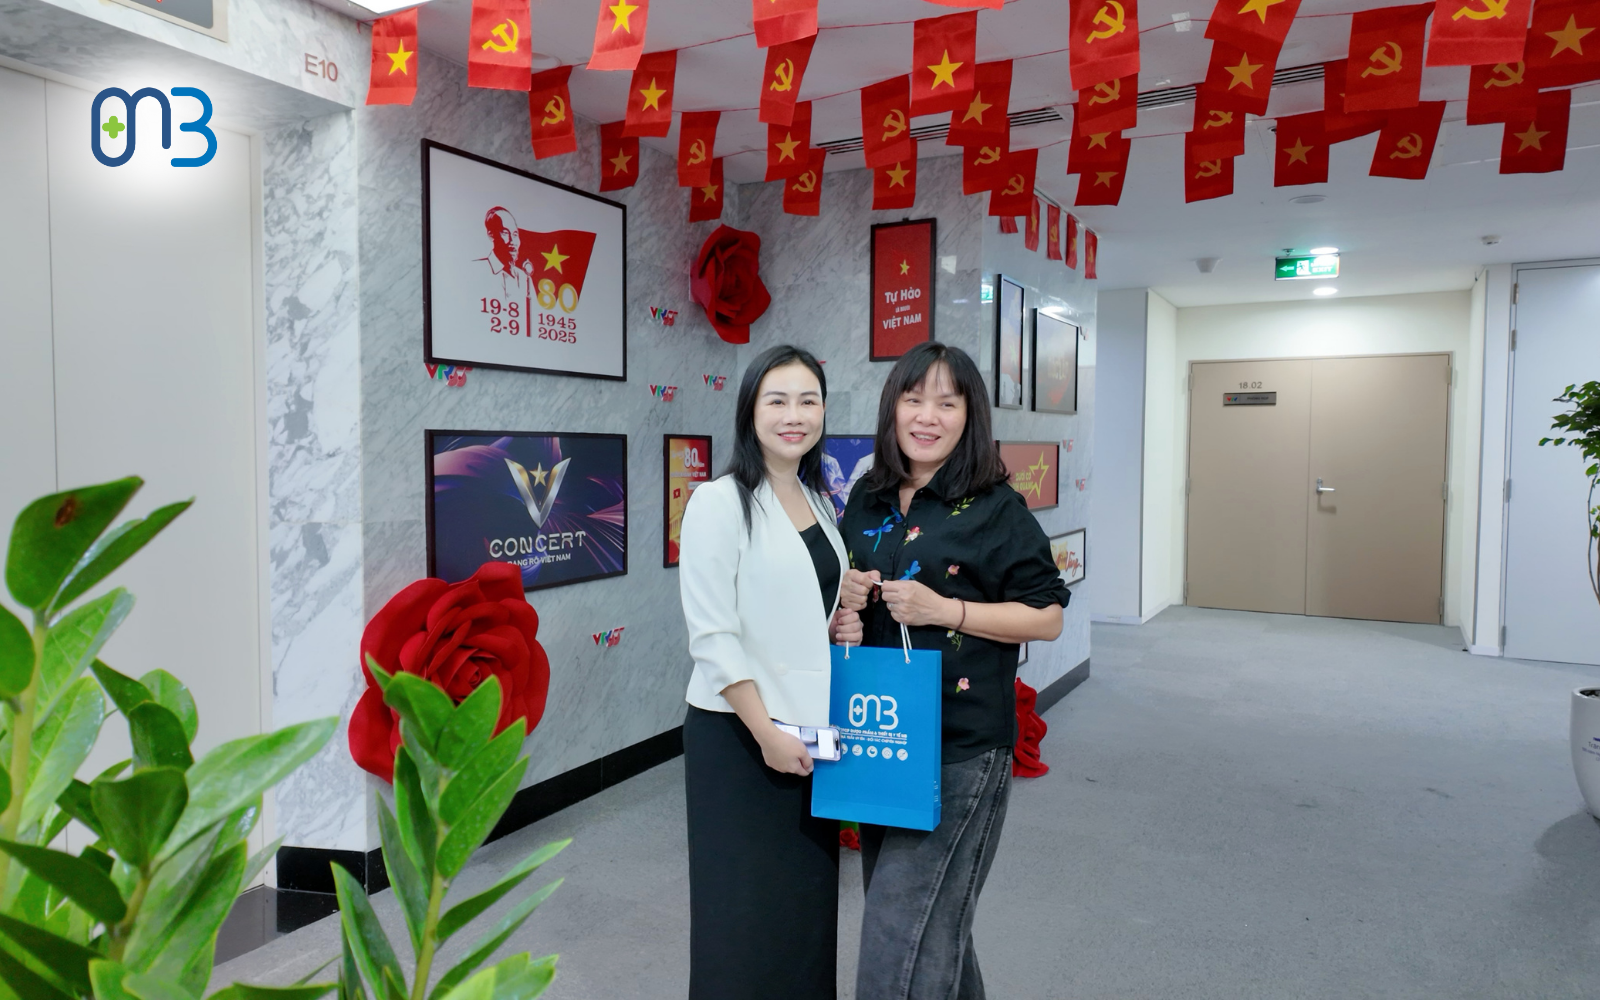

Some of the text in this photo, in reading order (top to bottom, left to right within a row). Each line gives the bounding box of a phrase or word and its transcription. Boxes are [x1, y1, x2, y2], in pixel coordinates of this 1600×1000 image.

[304, 53, 338, 82] E10
[537, 278, 579, 314] 80
[480, 297, 520, 318] 19-8
[490, 316, 520, 335] 2-9
[538, 313, 577, 330] 1945
[882, 313, 922, 330] VIỆT NAM
[538, 327, 577, 344] 2025
[1239, 381, 1263, 389] 18.02
[684, 447, 698, 468] 80
[489, 531, 586, 558] CONCERT
[556, 553, 571, 561] NAM
